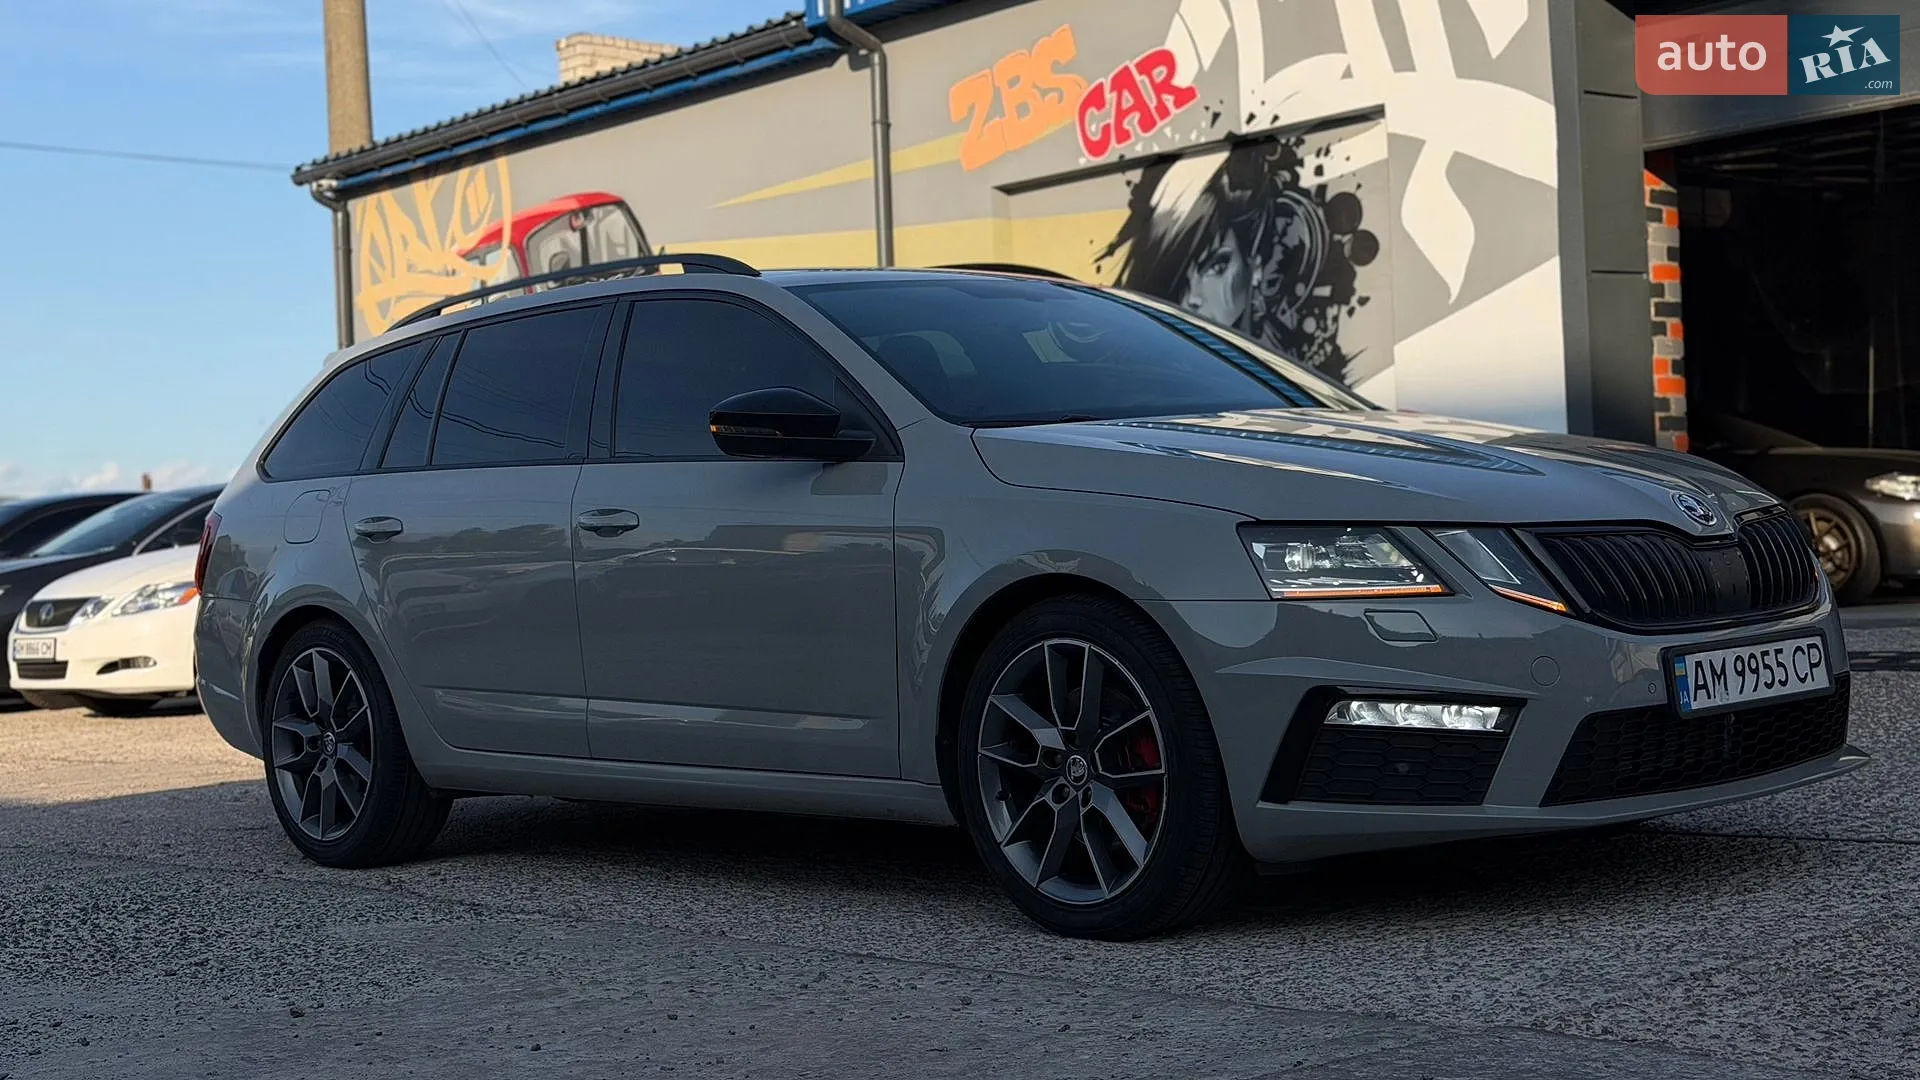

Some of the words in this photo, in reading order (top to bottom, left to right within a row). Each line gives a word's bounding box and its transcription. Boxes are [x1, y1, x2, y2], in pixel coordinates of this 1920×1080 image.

[949, 23, 1090, 172] ZBS
[1075, 46, 1199, 160] CAR
[1693, 657, 1729, 702] AM
[1733, 648, 1789, 695] 9955
[1792, 643, 1823, 684] CP
